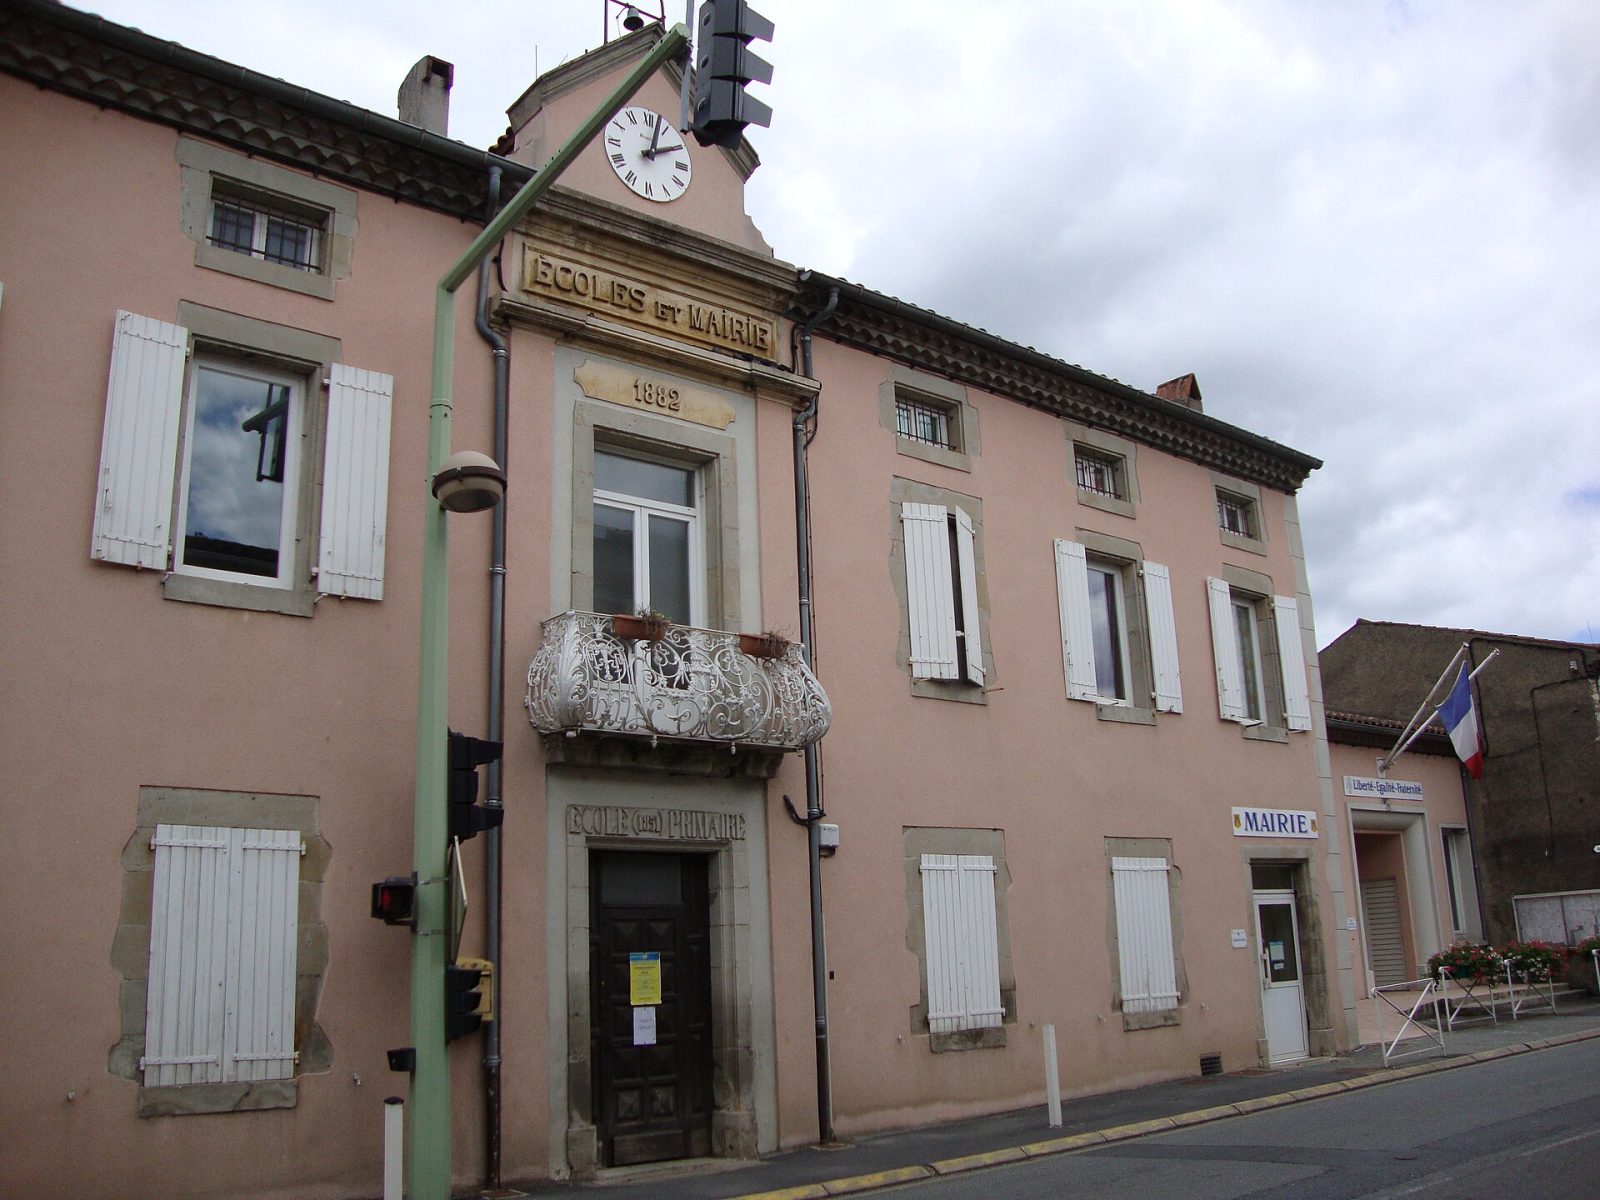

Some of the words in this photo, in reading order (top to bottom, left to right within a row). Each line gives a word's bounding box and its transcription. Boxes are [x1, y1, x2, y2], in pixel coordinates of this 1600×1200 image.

[654, 300, 681, 324] ET
[633, 378, 681, 412] 1882
[668, 809, 747, 841] PRIMAIRE
[1244, 811, 1309, 834] MAIRIE
